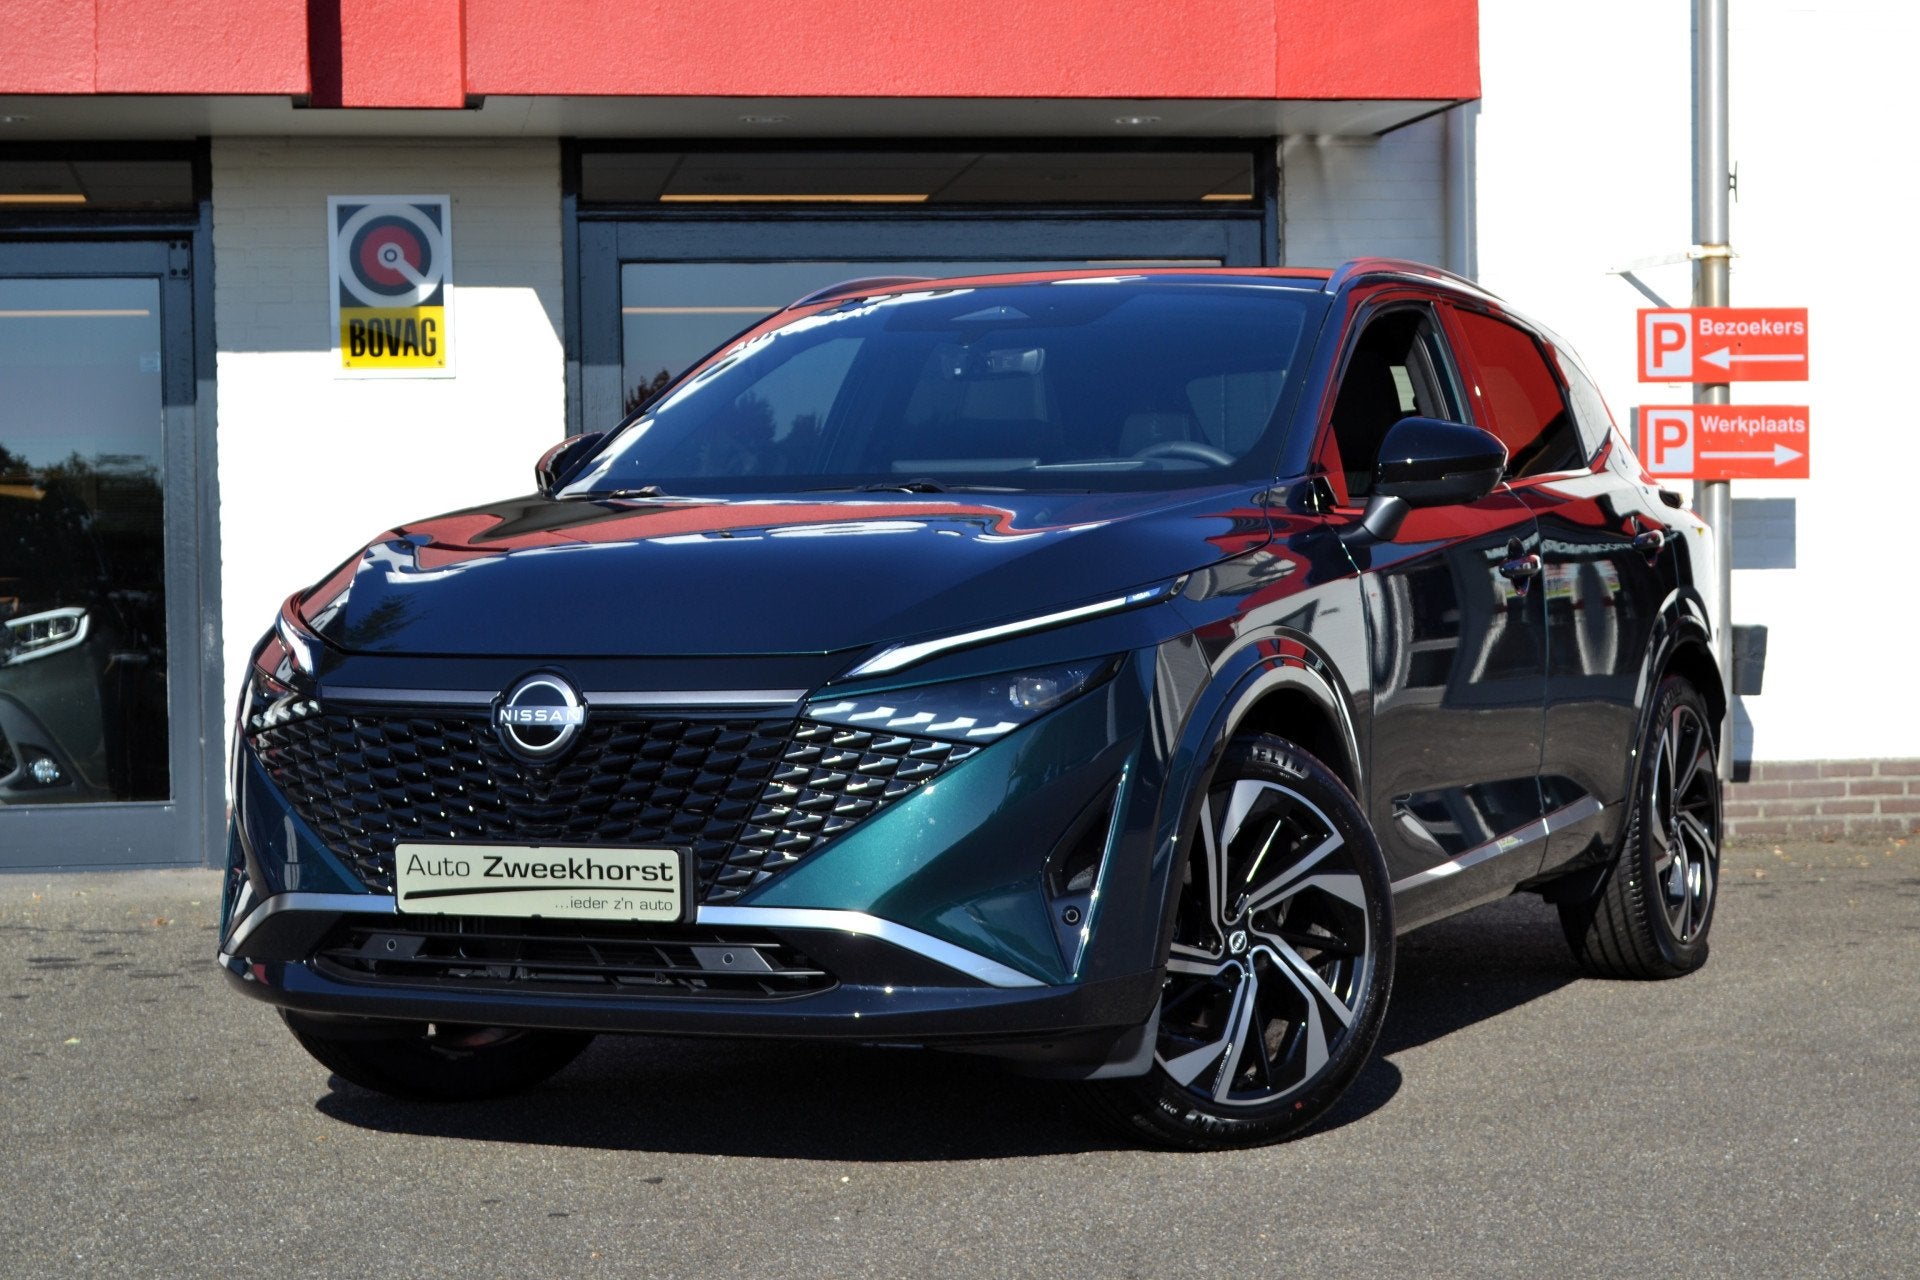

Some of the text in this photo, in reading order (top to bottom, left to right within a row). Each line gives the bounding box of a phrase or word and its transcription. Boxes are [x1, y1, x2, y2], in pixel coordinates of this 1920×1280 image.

[349, 317, 437, 357] BOVAG
[1699, 318, 1805, 336] Bezoekers
[1653, 322, 1687, 369] P
[1700, 415, 1806, 437] Werkplaats
[1654, 418, 1689, 465] P
[500, 709, 581, 722] NISSAN
[406, 854, 674, 881] Auto Zweekhorst
[614, 897, 633, 911] z'n
[639, 899, 674, 912] auto
